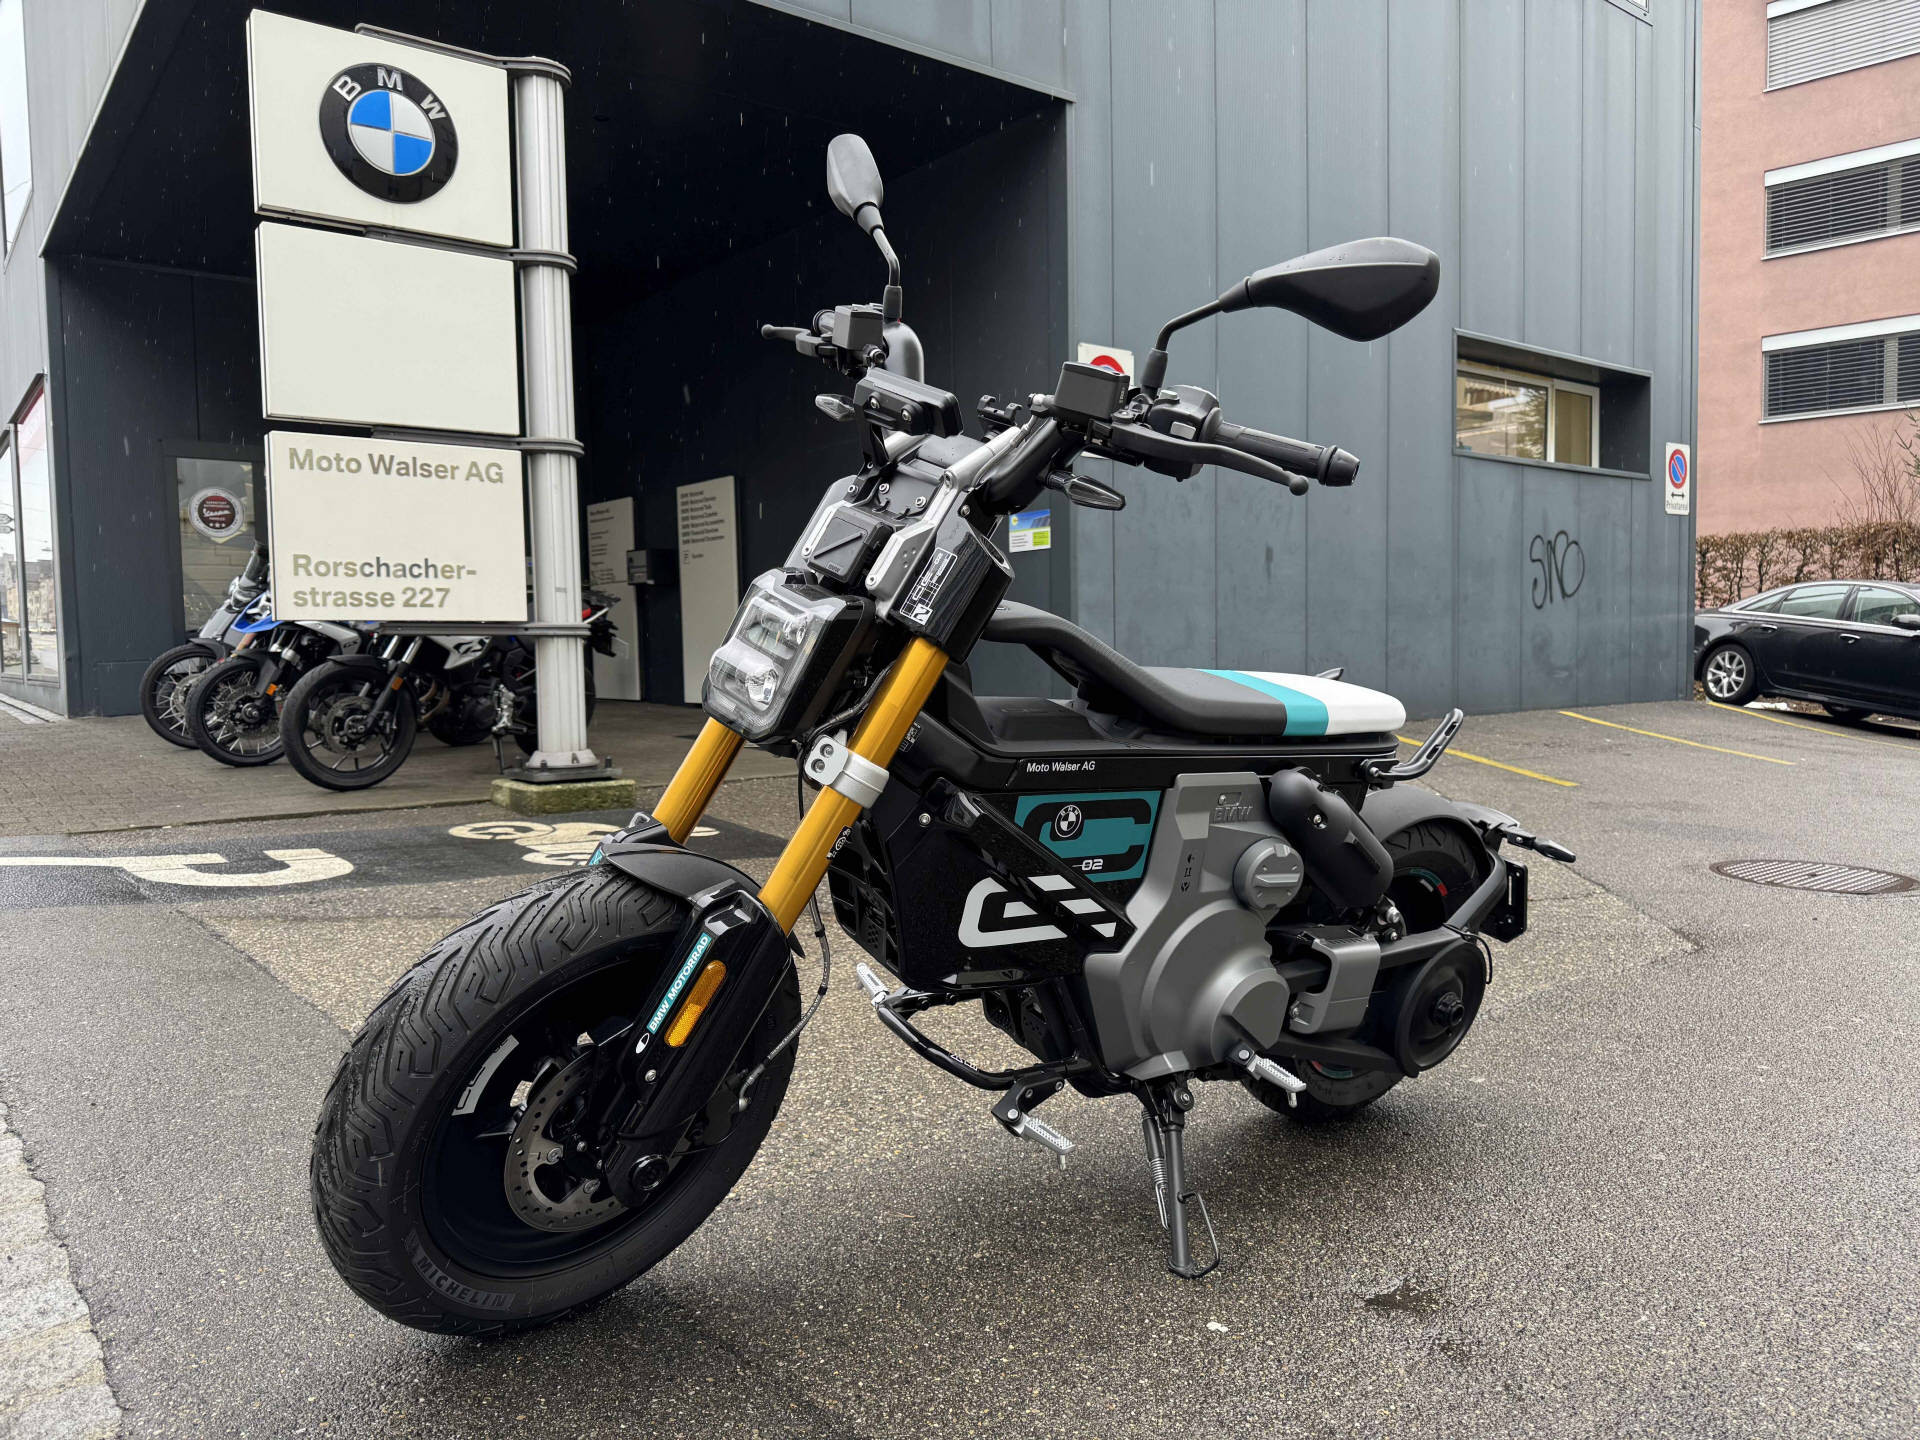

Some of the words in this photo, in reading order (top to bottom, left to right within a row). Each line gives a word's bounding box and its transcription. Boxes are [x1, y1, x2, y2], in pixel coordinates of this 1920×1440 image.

[332, 66, 447, 120] BMW
[288, 447, 362, 474] Moto
[368, 453, 460, 480] Walser
[465, 461, 504, 484] AG
[292, 554, 478, 581] Rorschacher-
[293, 586, 395, 608] strasse
[401, 587, 451, 609] 227
[1026, 762, 1050, 773] Moto
[1052, 761, 1080, 772] Walser
[1081, 760, 1096, 771] AG
[1213, 805, 1254, 823] BMW
[649, 1000, 670, 1032] BMW
[667, 936, 710, 1000] MOTORRAD
[416, 1256, 506, 1307] MICHELIN
